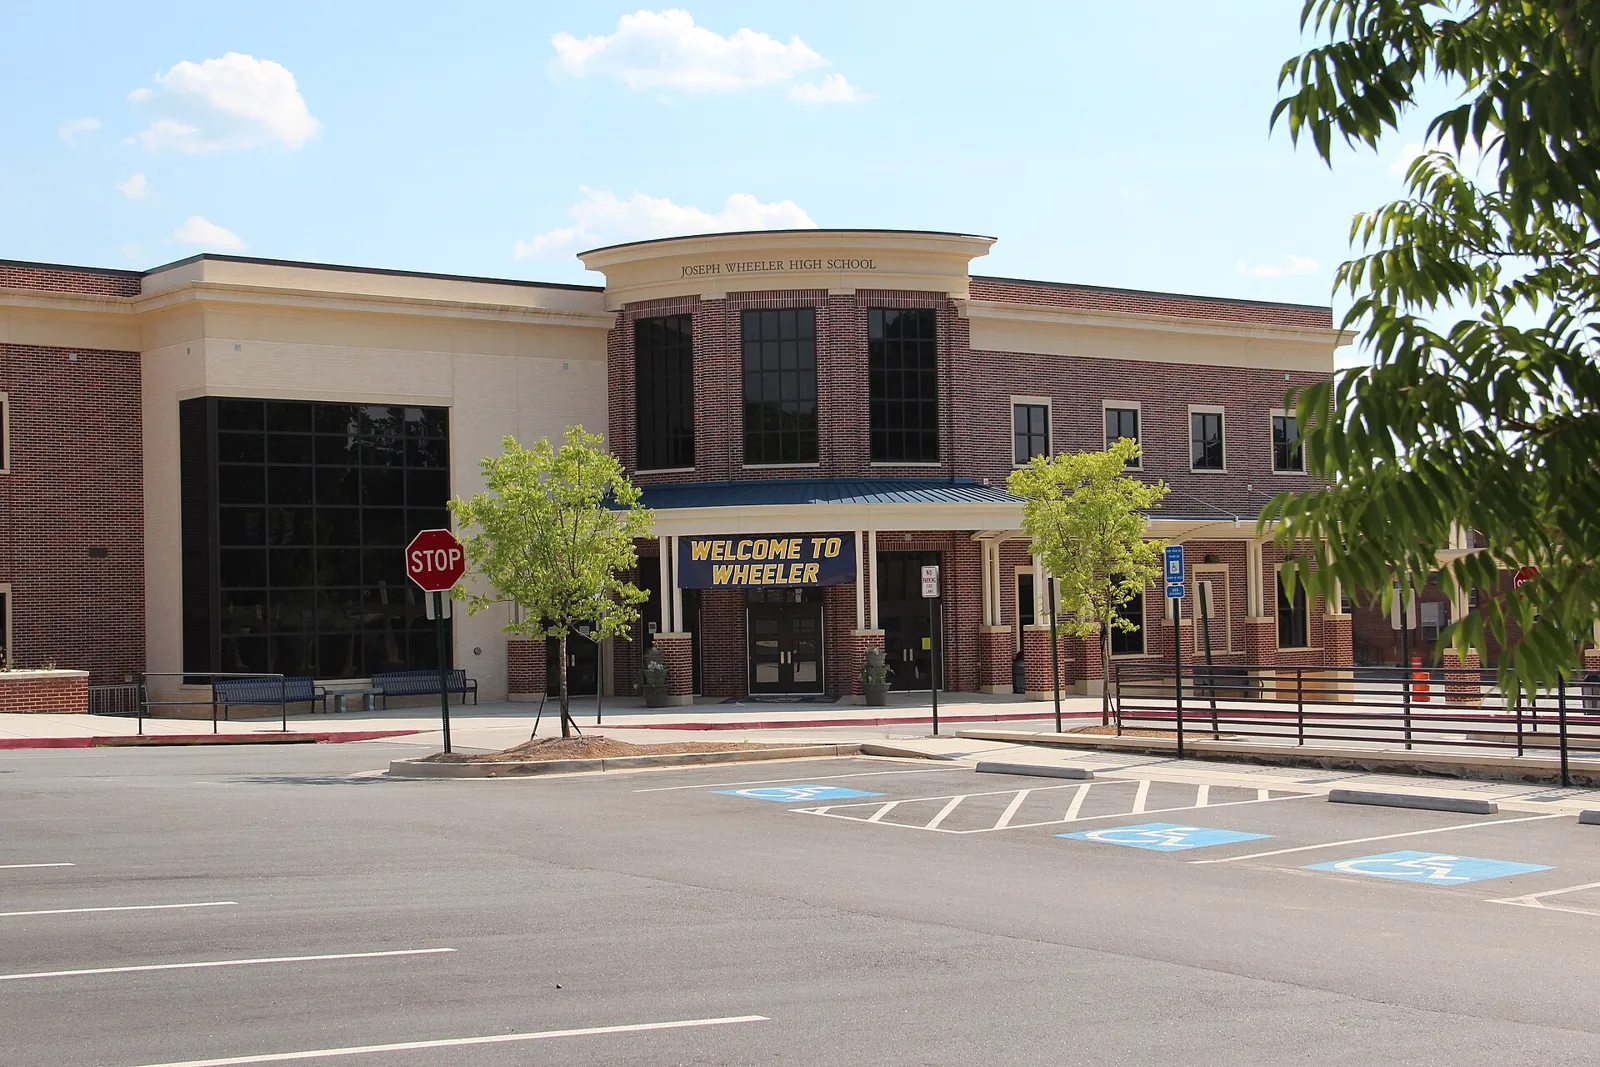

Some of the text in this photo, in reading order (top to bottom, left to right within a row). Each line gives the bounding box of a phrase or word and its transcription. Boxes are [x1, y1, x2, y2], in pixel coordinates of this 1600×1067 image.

[681, 258, 877, 279] JOSEPH WHEELER HIGH SCHOOL
[411, 548, 461, 573] STOP
[691, 537, 842, 561] WELCOME TO
[712, 562, 820, 585] WHEELER
